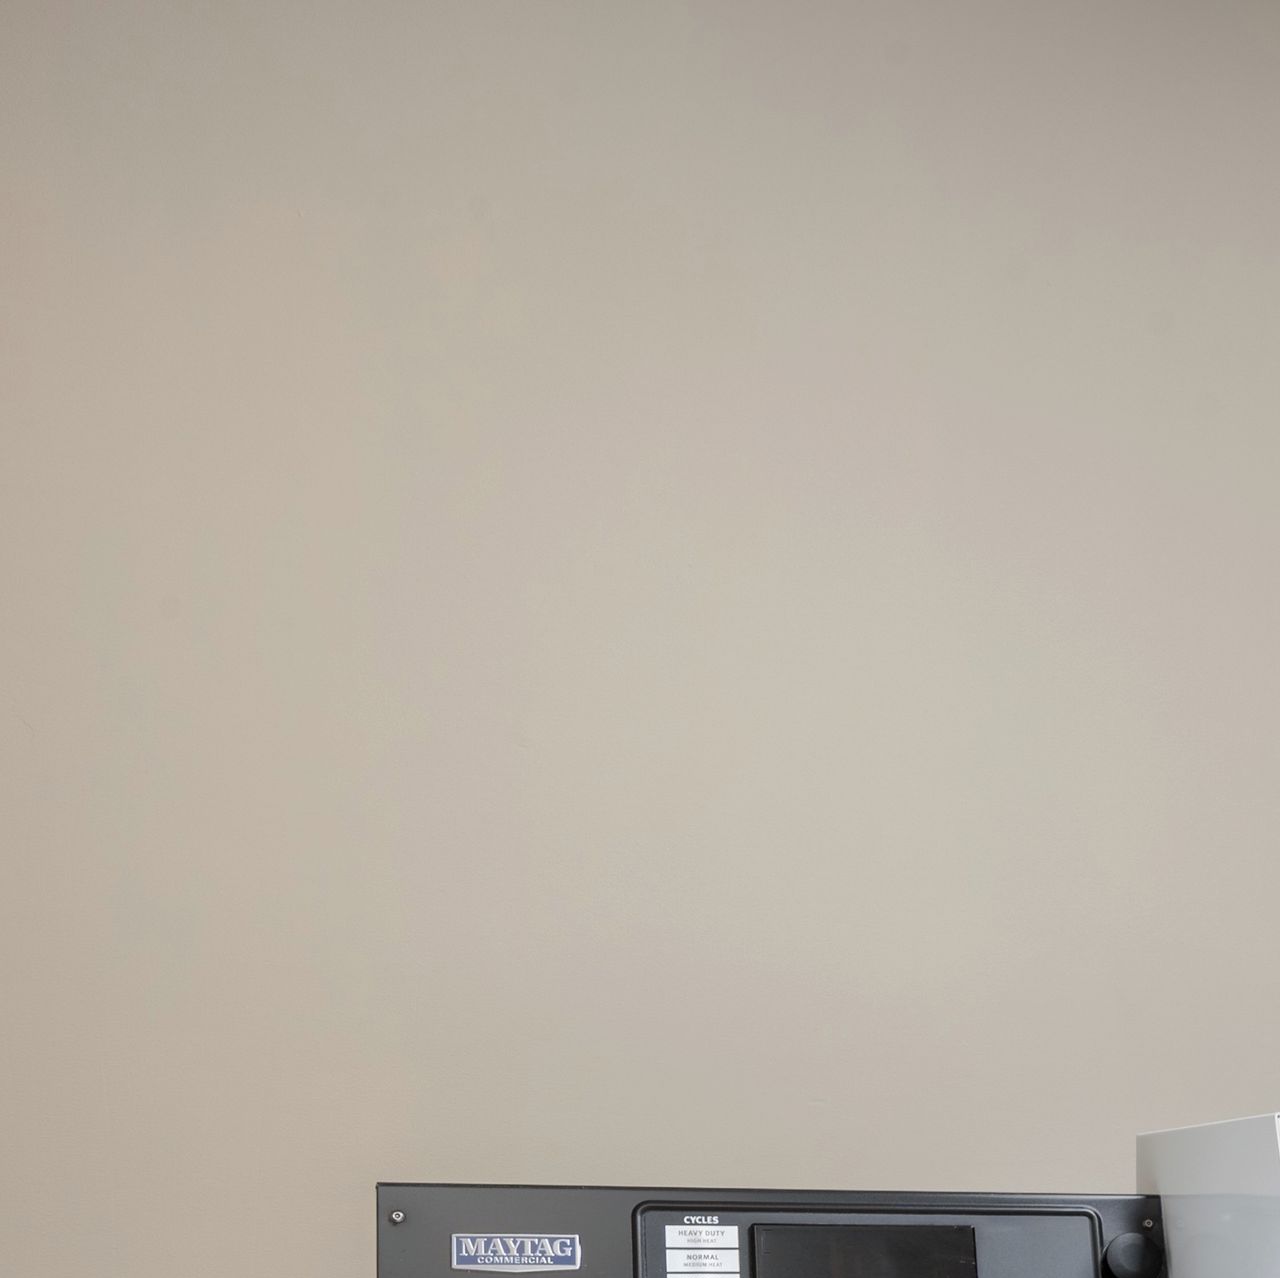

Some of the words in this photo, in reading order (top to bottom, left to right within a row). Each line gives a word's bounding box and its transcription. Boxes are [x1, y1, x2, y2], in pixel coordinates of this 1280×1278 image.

[683, 1215, 720, 1225] CYCLES
[459, 1238, 573, 1257] MAYTAG
[477, 1256, 554, 1264] COMMERCIAL
